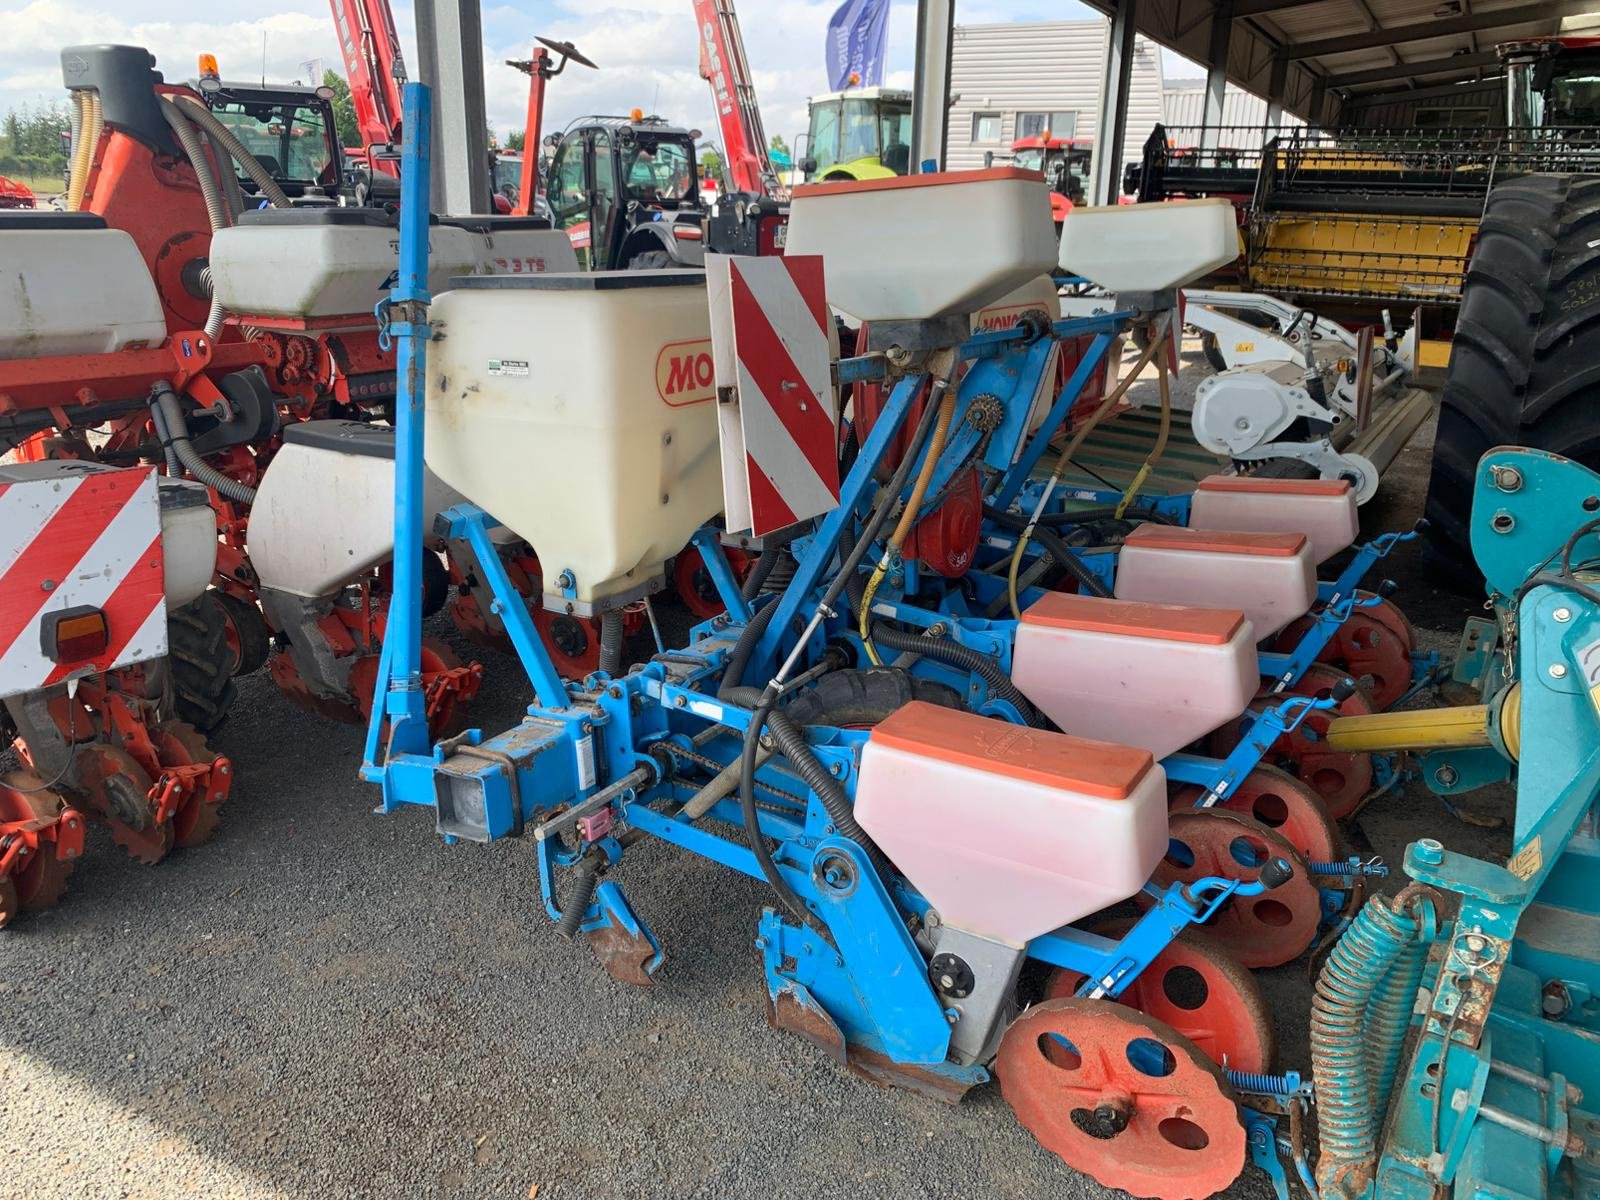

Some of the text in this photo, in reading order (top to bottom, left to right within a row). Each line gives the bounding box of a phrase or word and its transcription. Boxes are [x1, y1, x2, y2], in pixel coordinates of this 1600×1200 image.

[703, 22, 726, 91] CASE
[511, 258, 522, 272] 3
[665, 353, 715, 395] MO
